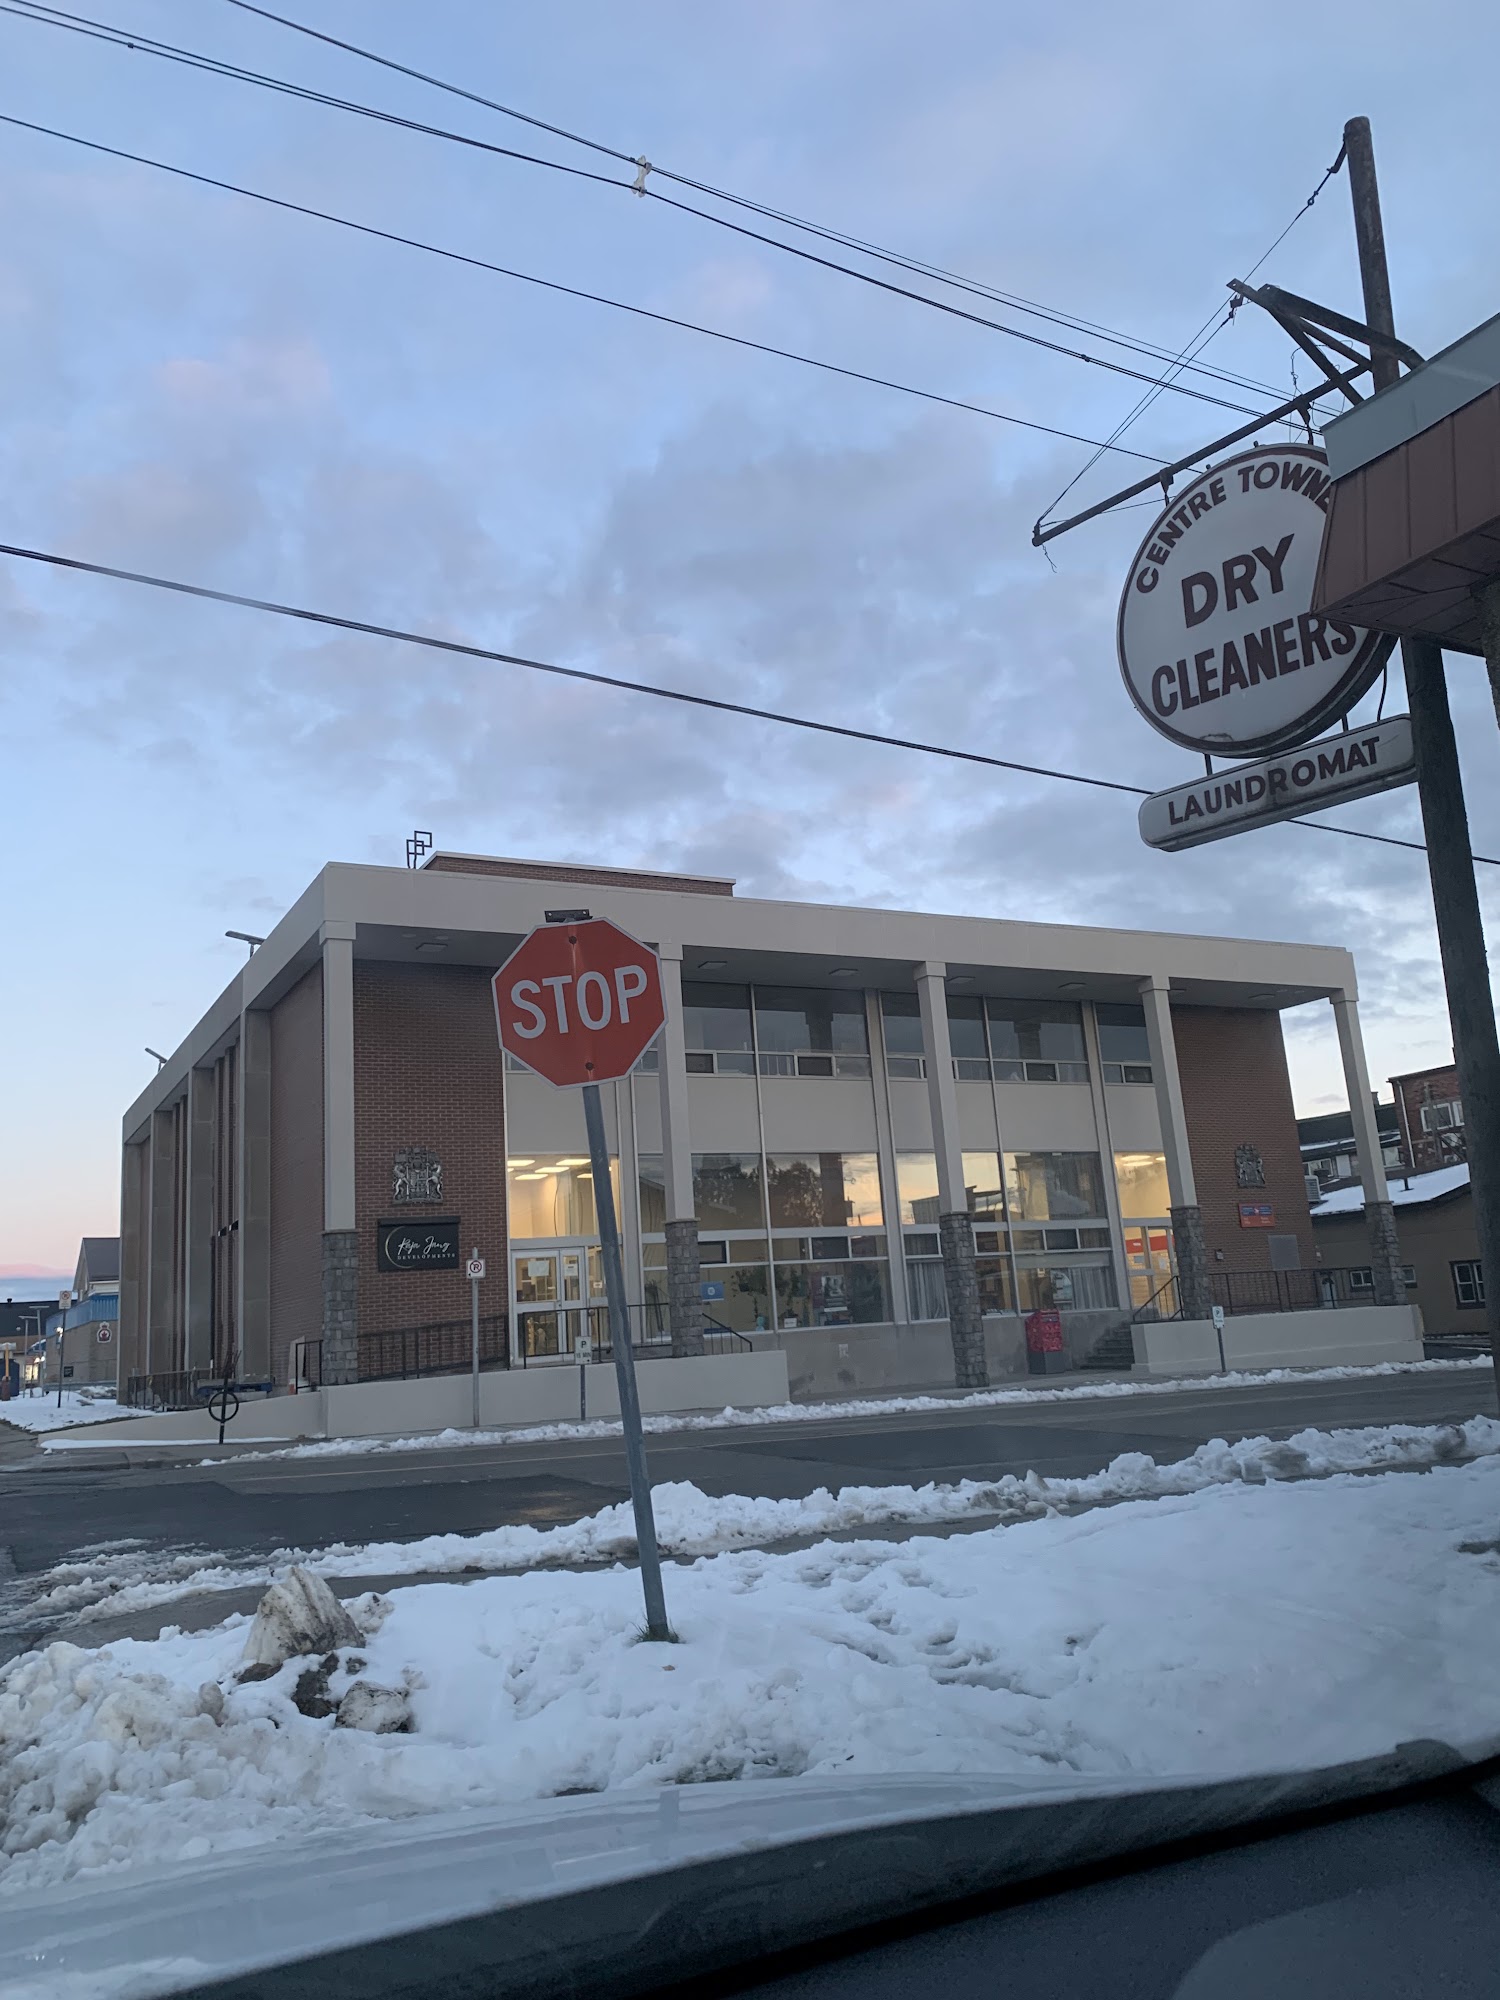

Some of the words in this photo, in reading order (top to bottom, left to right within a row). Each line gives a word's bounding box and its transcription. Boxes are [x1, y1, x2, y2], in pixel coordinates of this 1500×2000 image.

[1136, 477, 1227, 594] CENTRE
[1181, 533, 1295, 628] DRY
[1151, 612, 1357, 717] CLEANERS
[1168, 736, 1380, 826] LAUNDROMAT
[510, 964, 648, 1039] STOP
[580, 1340, 587, 1349] P
